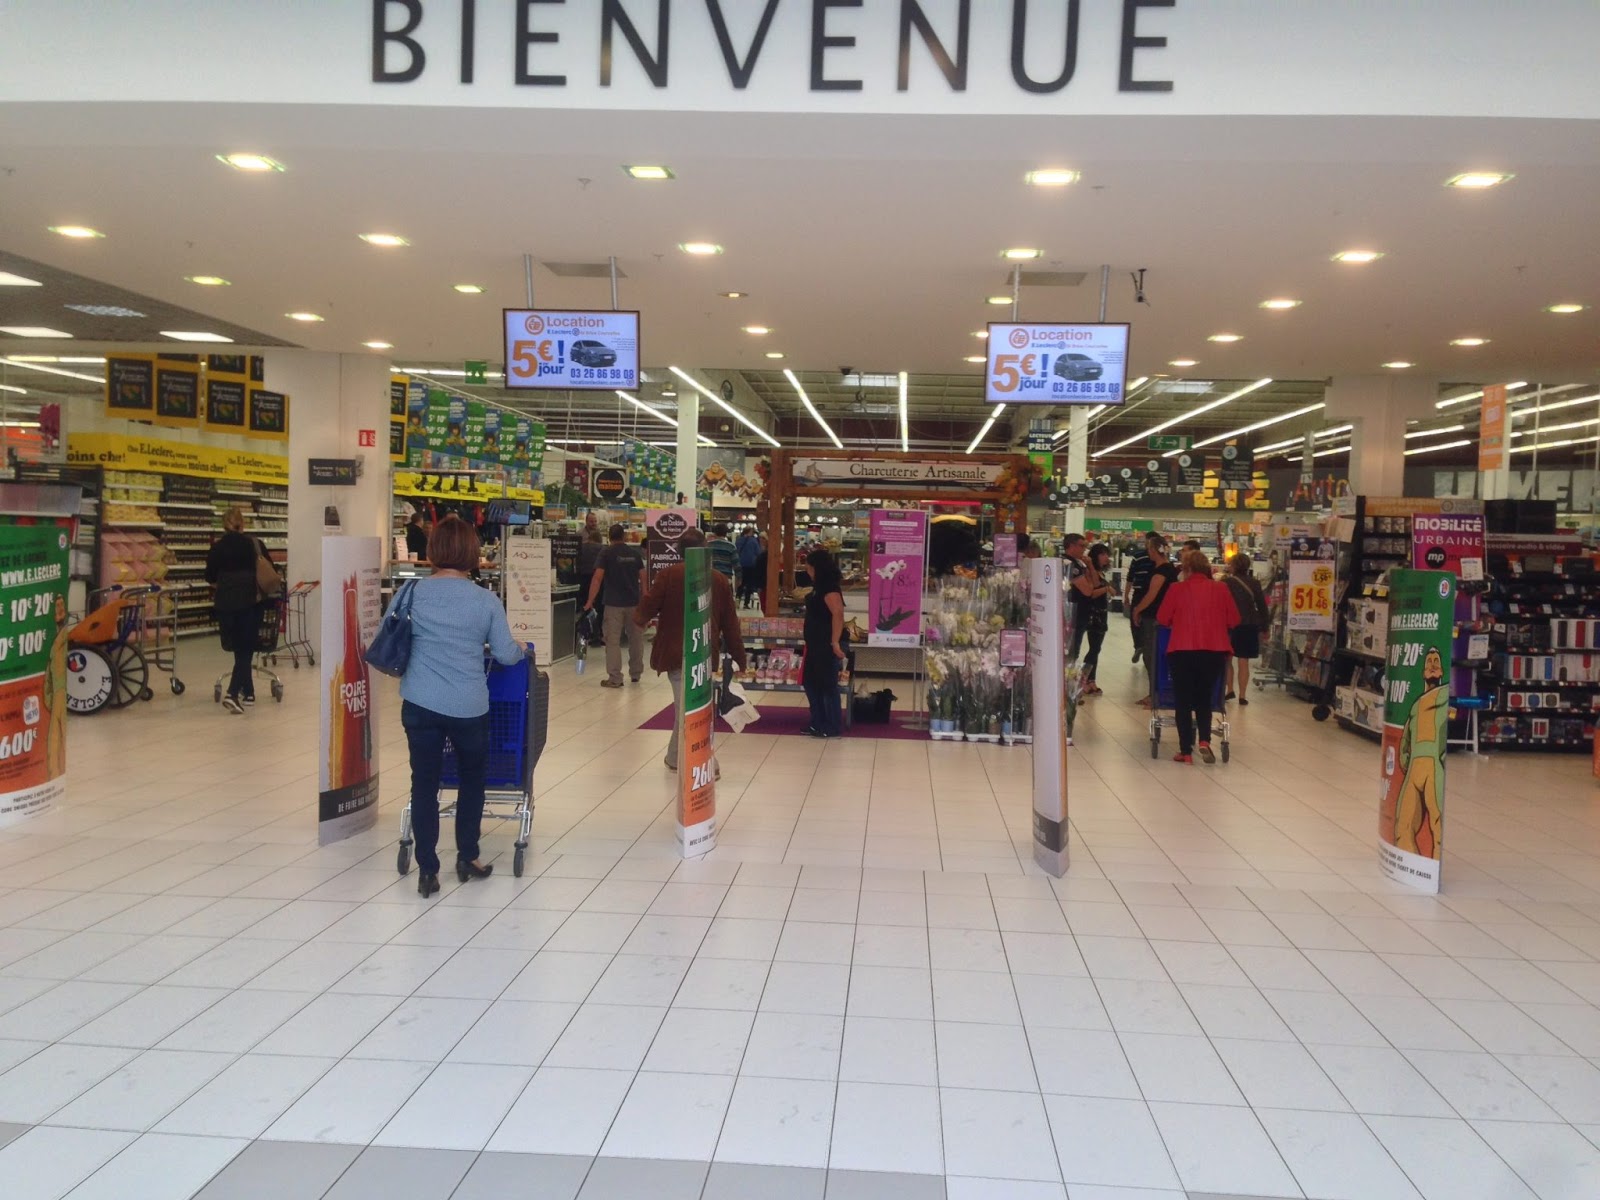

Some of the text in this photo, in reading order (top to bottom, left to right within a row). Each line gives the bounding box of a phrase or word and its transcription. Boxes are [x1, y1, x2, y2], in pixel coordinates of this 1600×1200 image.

[373, 0, 1174, 94] BIENVENUE
[547, 317, 604, 327] Location
[1032, 329, 1092, 340] Location
[538, 363, 564, 376] jour
[571, 369, 581, 378] 03
[584, 369, 594, 378] 26
[597, 369, 607, 378] 86
[610, 369, 621, 378] 98
[1018, 377, 1047, 391] jour
[1053, 383, 1063, 392] 03
[1066, 383, 1078, 392] 26
[1080, 383, 1091, 392] 86
[1094, 383, 1105, 392] 98
[1028, 443, 1052, 451] PRIX
[66, 451, 96, 462] oins
[850, 463, 987, 479] Charcuterie Artisanale
[1100, 520, 1132, 530] TERREAUX
[1192, 522, 1218, 532] MINERAU
[1414, 535, 1481, 547] URBAINE
[340, 680, 366, 699] FOIRE
[346, 695, 367, 713] VINS
